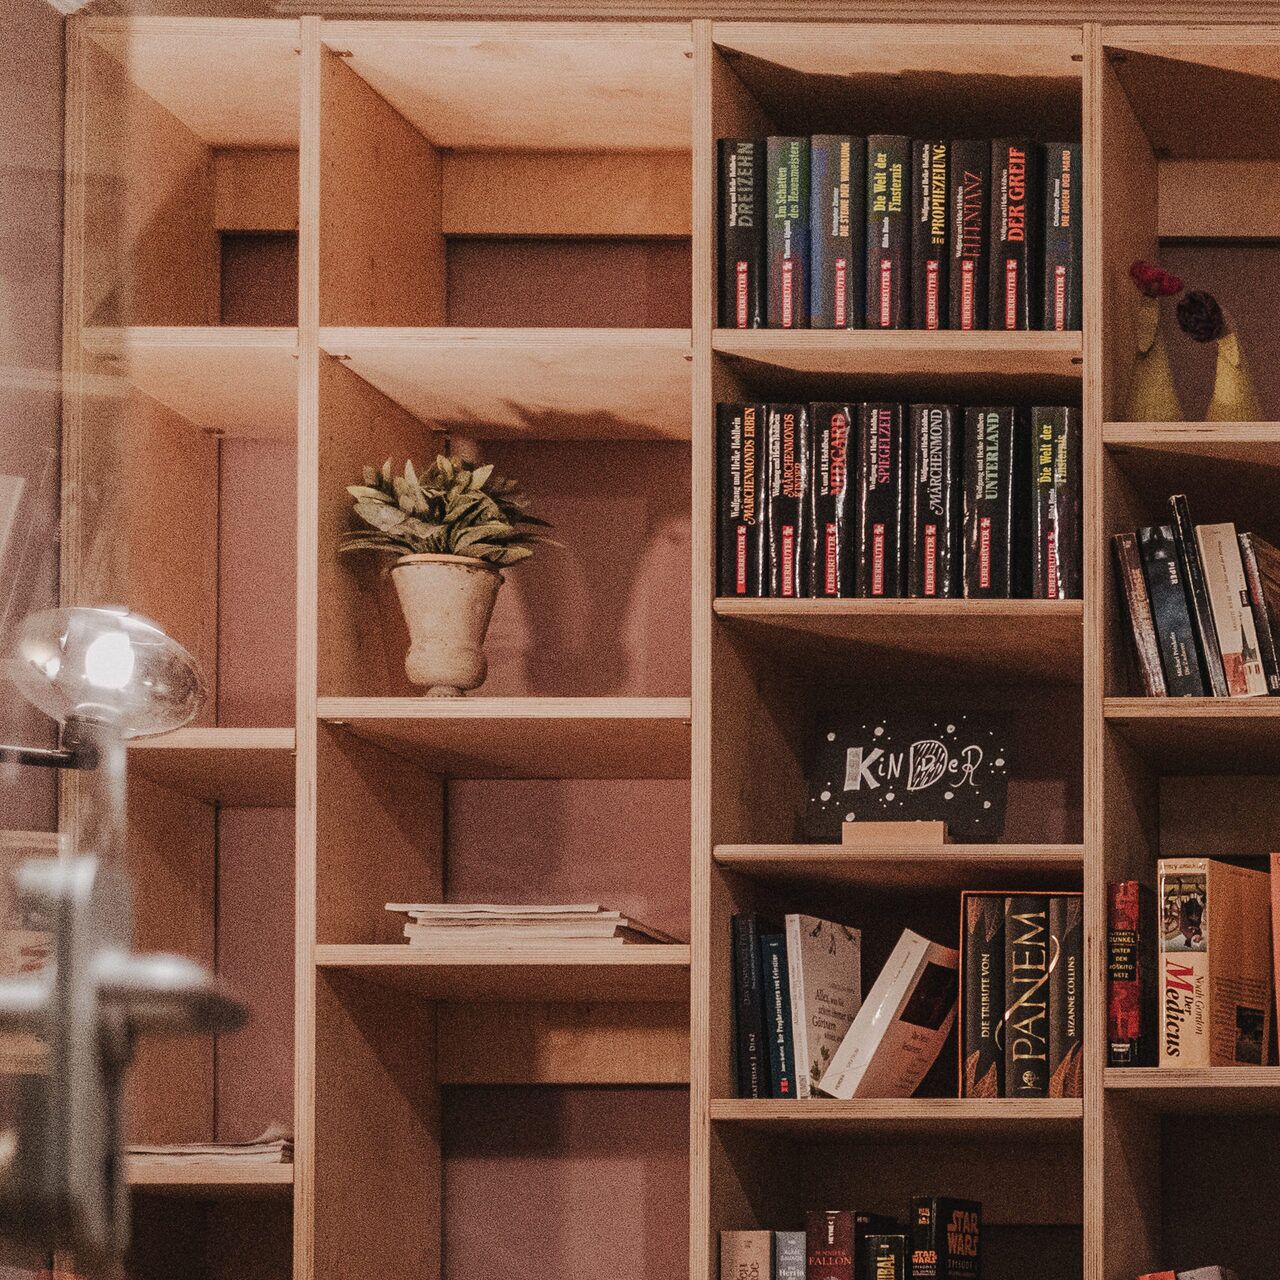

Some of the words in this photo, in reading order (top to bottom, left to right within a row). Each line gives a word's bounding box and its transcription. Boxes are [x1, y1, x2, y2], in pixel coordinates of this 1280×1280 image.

[874, 153, 886, 168] der
[1008, 146, 1026, 200] GREIF
[737, 142, 754, 227] DREIZEHN
[776, 167, 787, 204] Schatten
[874, 172, 886, 192] Welt
[889, 164, 902, 211] Finsternis
[932, 144, 946, 235] PROPHEZEIUNG
[776, 206, 787, 218] Im
[874, 196, 886, 211] Die
[1008, 204, 1026, 241] DER
[744, 408, 756, 437] ERBEN
[1040, 424, 1052, 440] der
[831, 414, 846, 496] MIDGARD
[878, 410, 891, 484] SPIEGELZEIT
[927, 409, 944, 515] MÄRCHENMOND
[986, 412, 999, 500] UNTERLAND
[1040, 442, 1052, 464] Welt
[742, 440, 756, 524] MÄRCHENMONDS
[1040, 468, 1052, 482] Die
[1168, 562, 1178, 584] PIPER
[982, 954, 990, 970] VON
[1067, 956, 1075, 995] COLLINS
[982, 970, 990, 1018] TRIBUTE
[1012, 911, 1047, 1062] PANEM
[1067, 996, 1075, 1036] SUZANNE
[1166, 958, 1194, 1057] Medicus
[1184, 995, 1192, 1016] Der
[982, 1020, 990, 1038] DIE
[948, 1210, 980, 1234] STAR
[808, 1256, 852, 1266] FALLON
[912, 1256, 938, 1264] WARS
[947, 1233, 978, 1257] WARS
